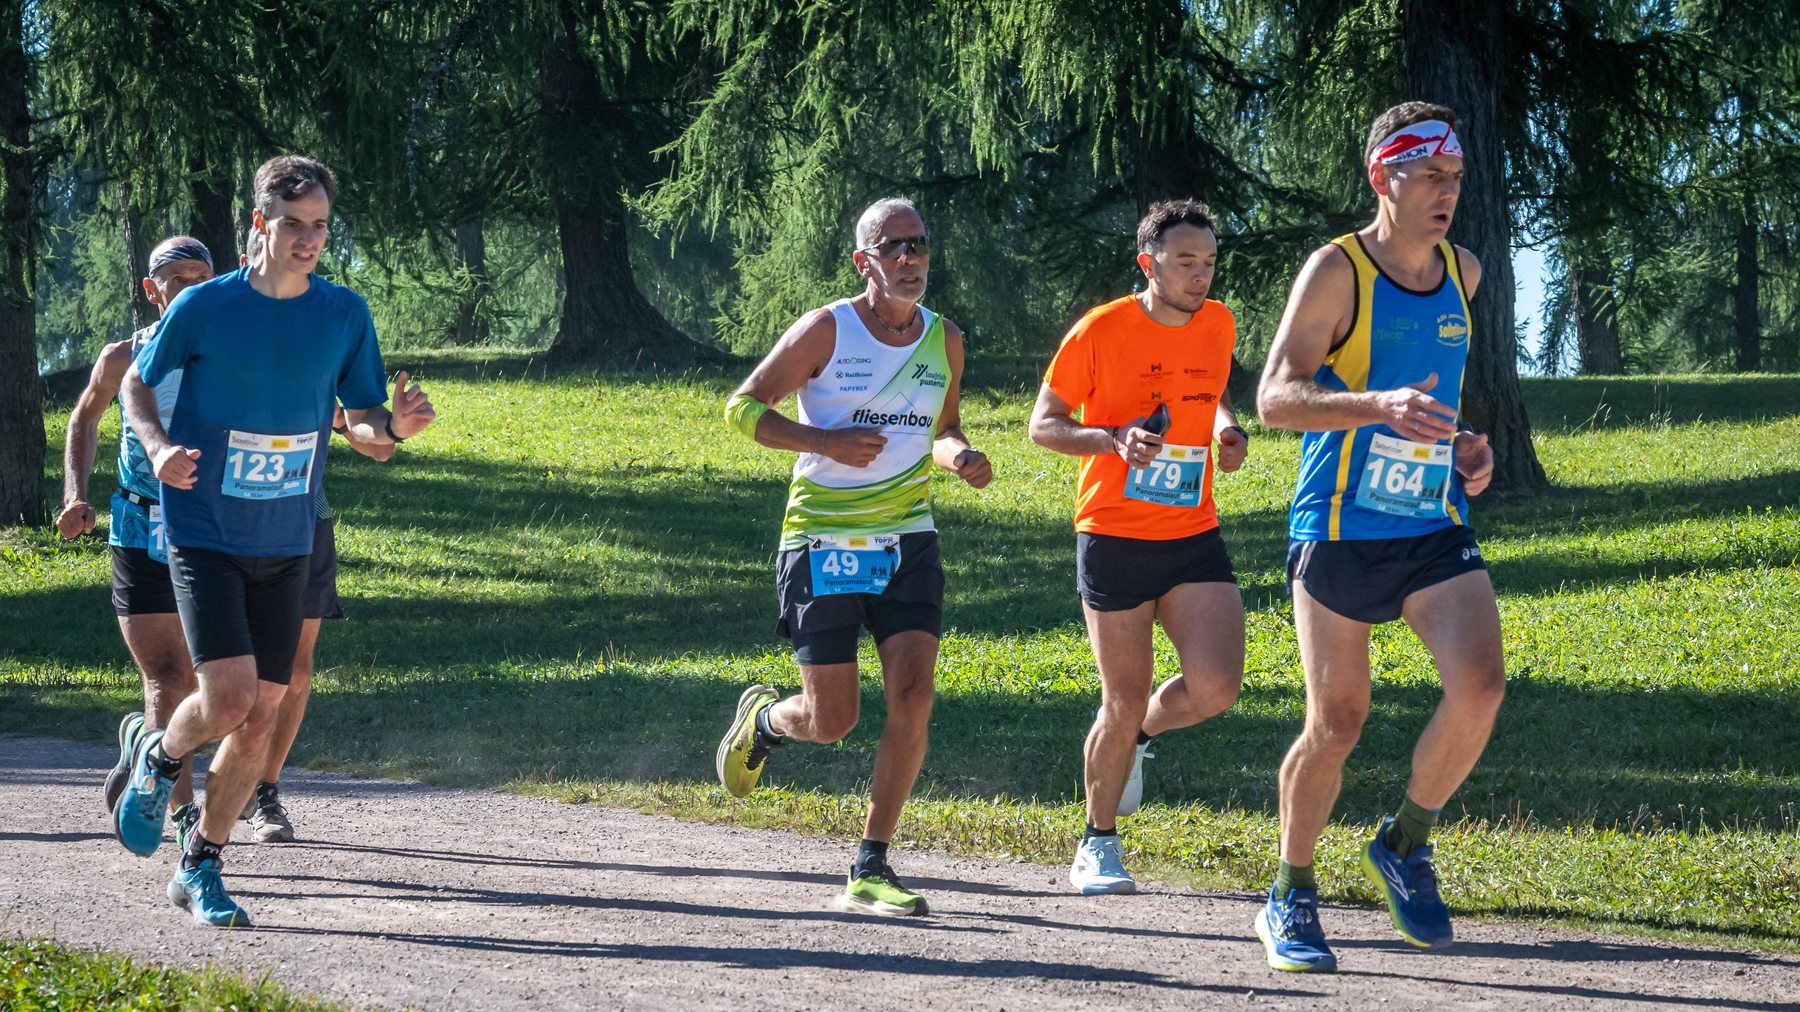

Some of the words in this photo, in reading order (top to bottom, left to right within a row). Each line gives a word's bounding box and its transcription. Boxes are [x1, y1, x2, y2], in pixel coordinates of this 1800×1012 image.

[852, 409, 934, 428] fliesenbau
[229, 451, 285, 482] 123
[1367, 458, 1425, 497] 164
[234, 482, 284, 492] Panoramalauf
[1135, 486, 1180, 499] Panoramalauf
[1369, 492, 1421, 509] Panoramalauf
[822, 551, 859, 576] 49
[824, 579, 873, 587] Panoramalauf
